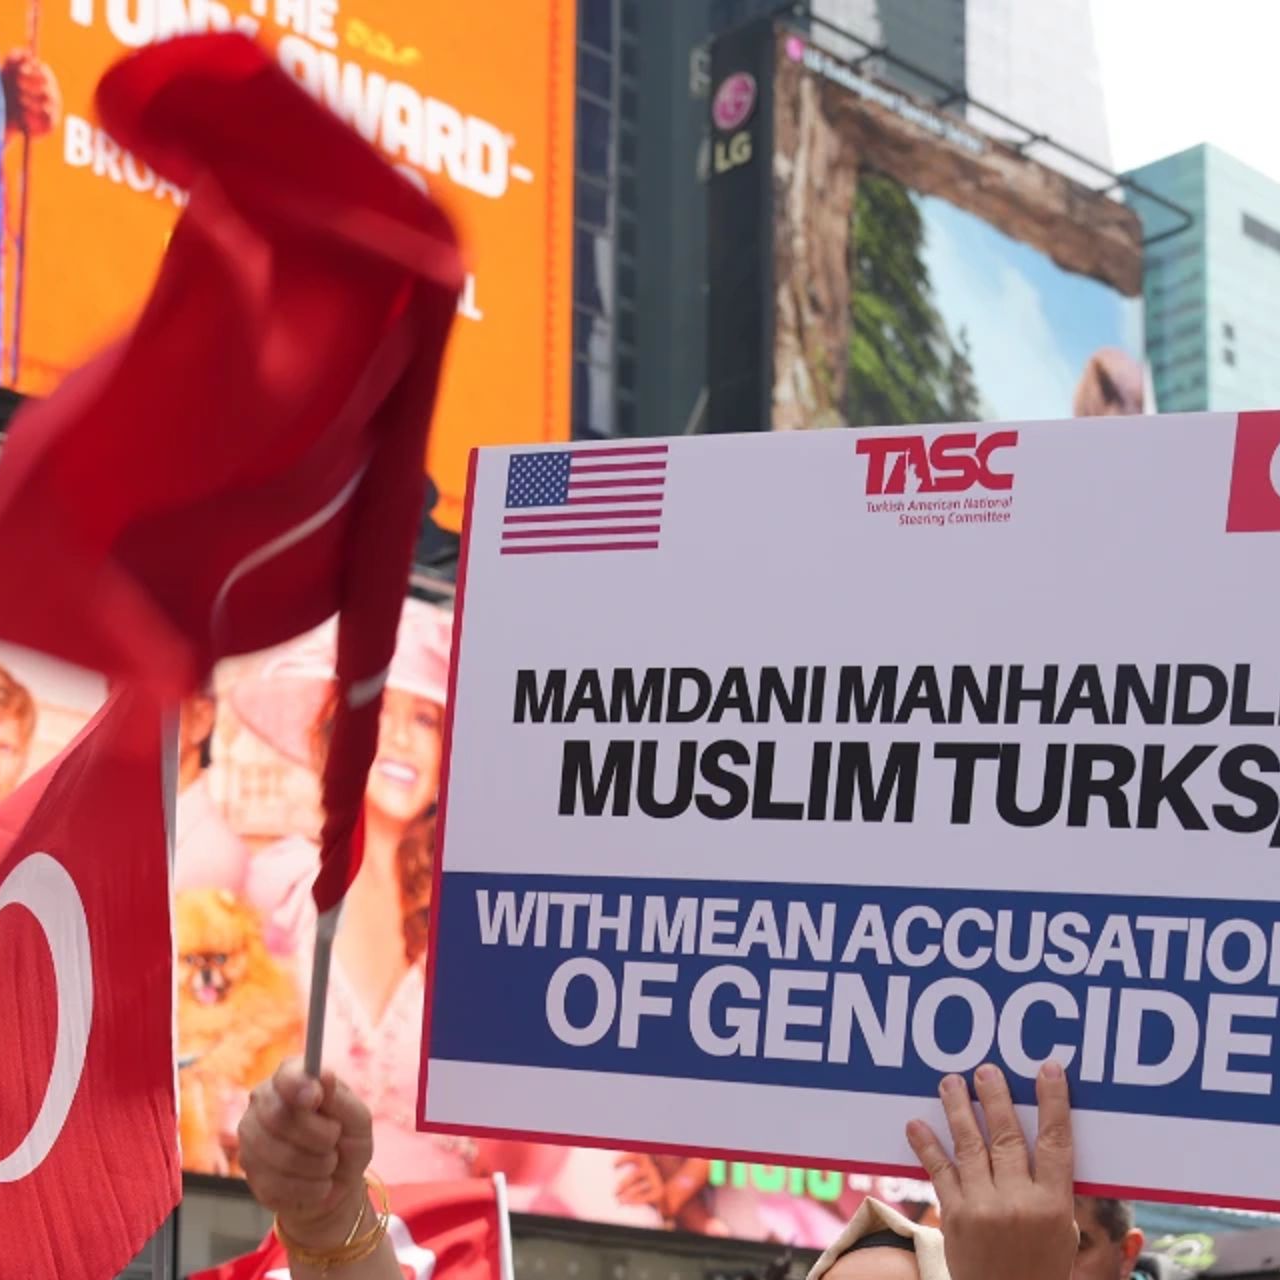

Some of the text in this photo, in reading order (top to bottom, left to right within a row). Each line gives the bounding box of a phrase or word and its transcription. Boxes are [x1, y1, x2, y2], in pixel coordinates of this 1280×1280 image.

[714, 131, 753, 173] LG
[856, 431, 1018, 495] TASC
[866, 496, 1012, 513] Turkish American National
[899, 512, 1011, 526] Steering Committee
[513, 667, 825, 725] MAMDANI
[558, 739, 921, 823] MUSLIM
[475, 890, 641, 952] WITH
[642, 897, 836, 962] MEAN
[544, 958, 1278, 1095] OF GENOCIDE
